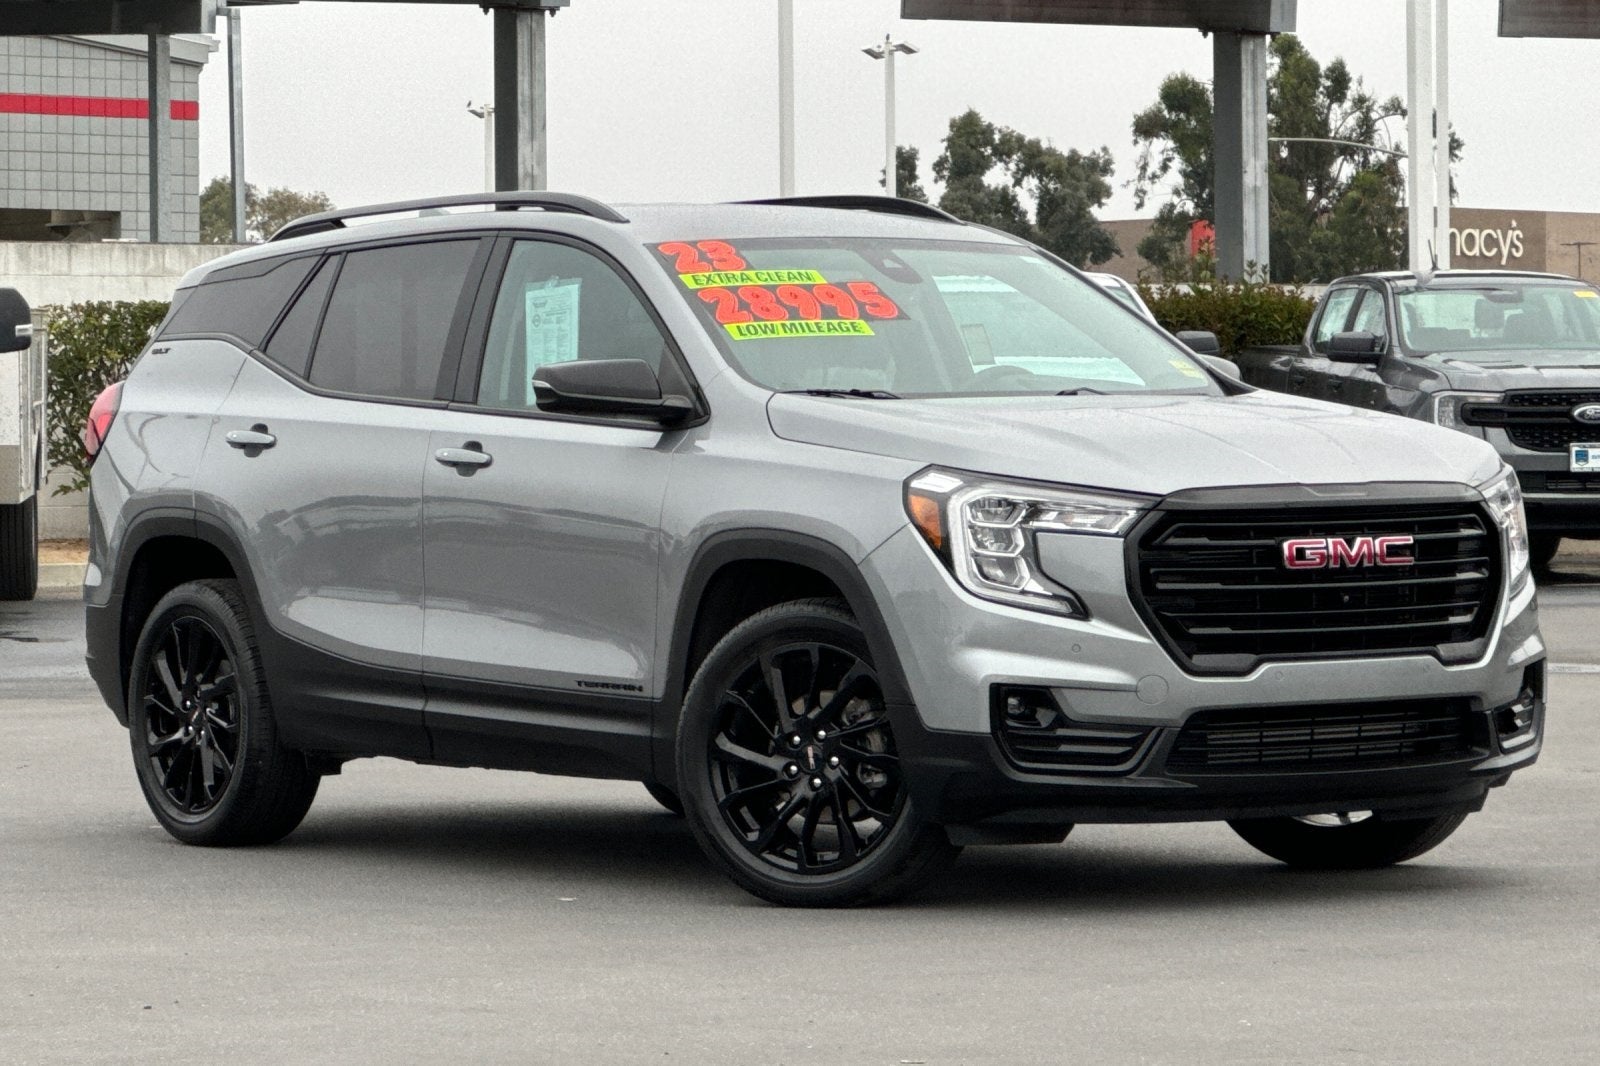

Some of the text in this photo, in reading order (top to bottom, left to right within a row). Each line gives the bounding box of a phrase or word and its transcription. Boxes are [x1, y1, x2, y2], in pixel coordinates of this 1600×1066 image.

[657, 240, 747, 273] 23
[691, 270, 816, 286] EXTRA CLEAN
[697, 281, 899, 324] 28995
[736, 321, 864, 337] LOW MILEAGE
[1282, 535, 1415, 570] GMC
